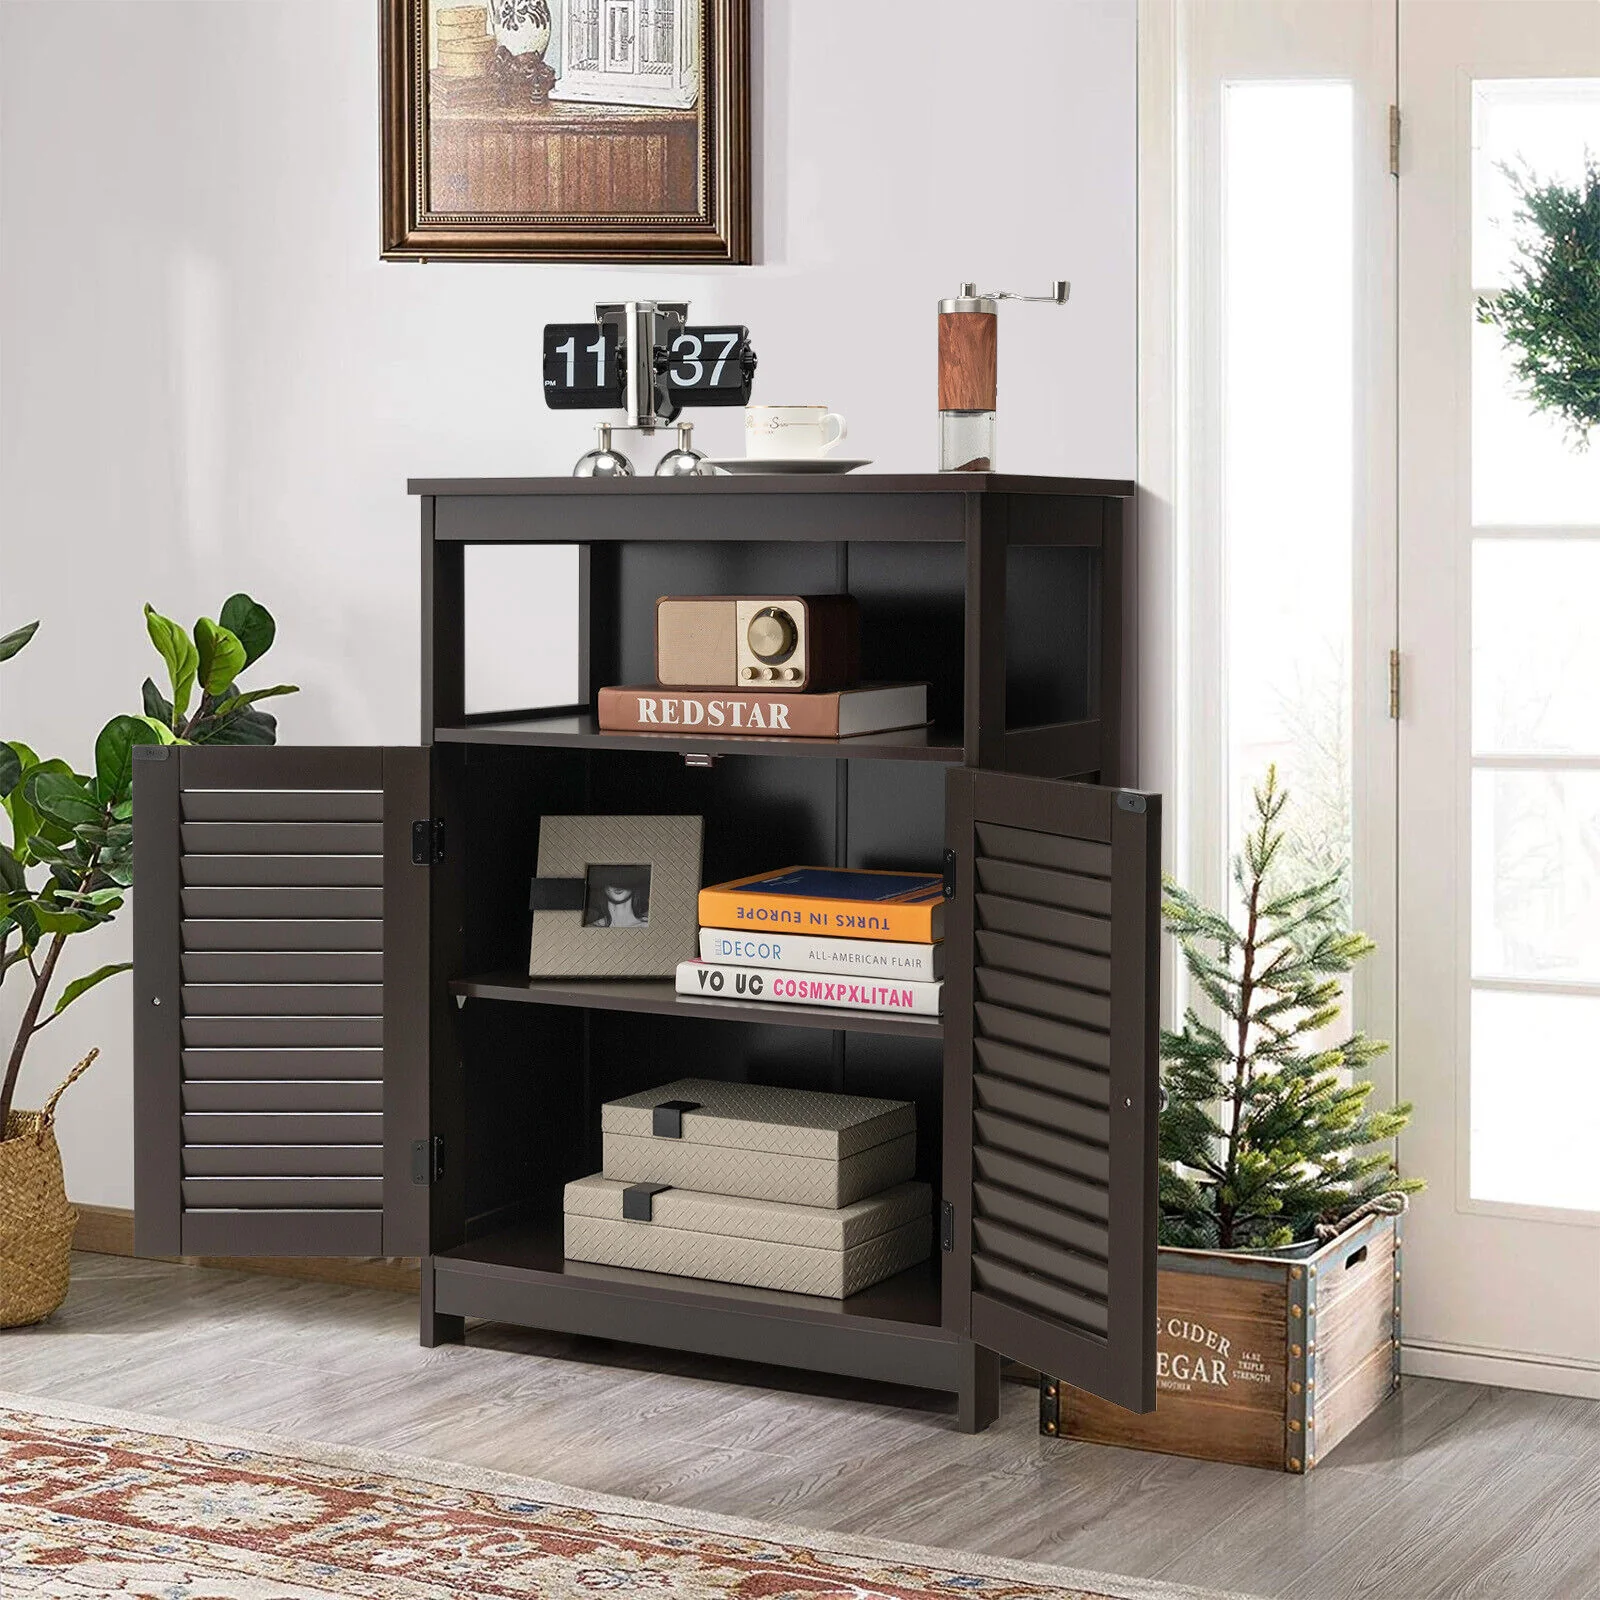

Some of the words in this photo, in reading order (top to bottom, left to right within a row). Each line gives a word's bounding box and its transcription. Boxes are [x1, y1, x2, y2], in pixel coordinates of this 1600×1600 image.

[555, 336, 606, 387] 11
[670, 333, 739, 387] 37
[636, 697, 791, 730] REDSTAR
[737, 907, 801, 924] EUROPE
[810, 912, 827, 926] IN
[836, 914, 890, 931] TURKS
[722, 939, 781, 960] DECOR
[808, 950, 888, 966] ALL-AMERICAN
[891, 956, 922, 968] FLAIR
[773, 978, 914, 1008] COSMXPXLITAN
[1167, 1318, 1231, 1359] CIDER
[1238, 1361, 1265, 1372] TRIPLE
[1232, 1370, 1271, 1384] STRENGTH
